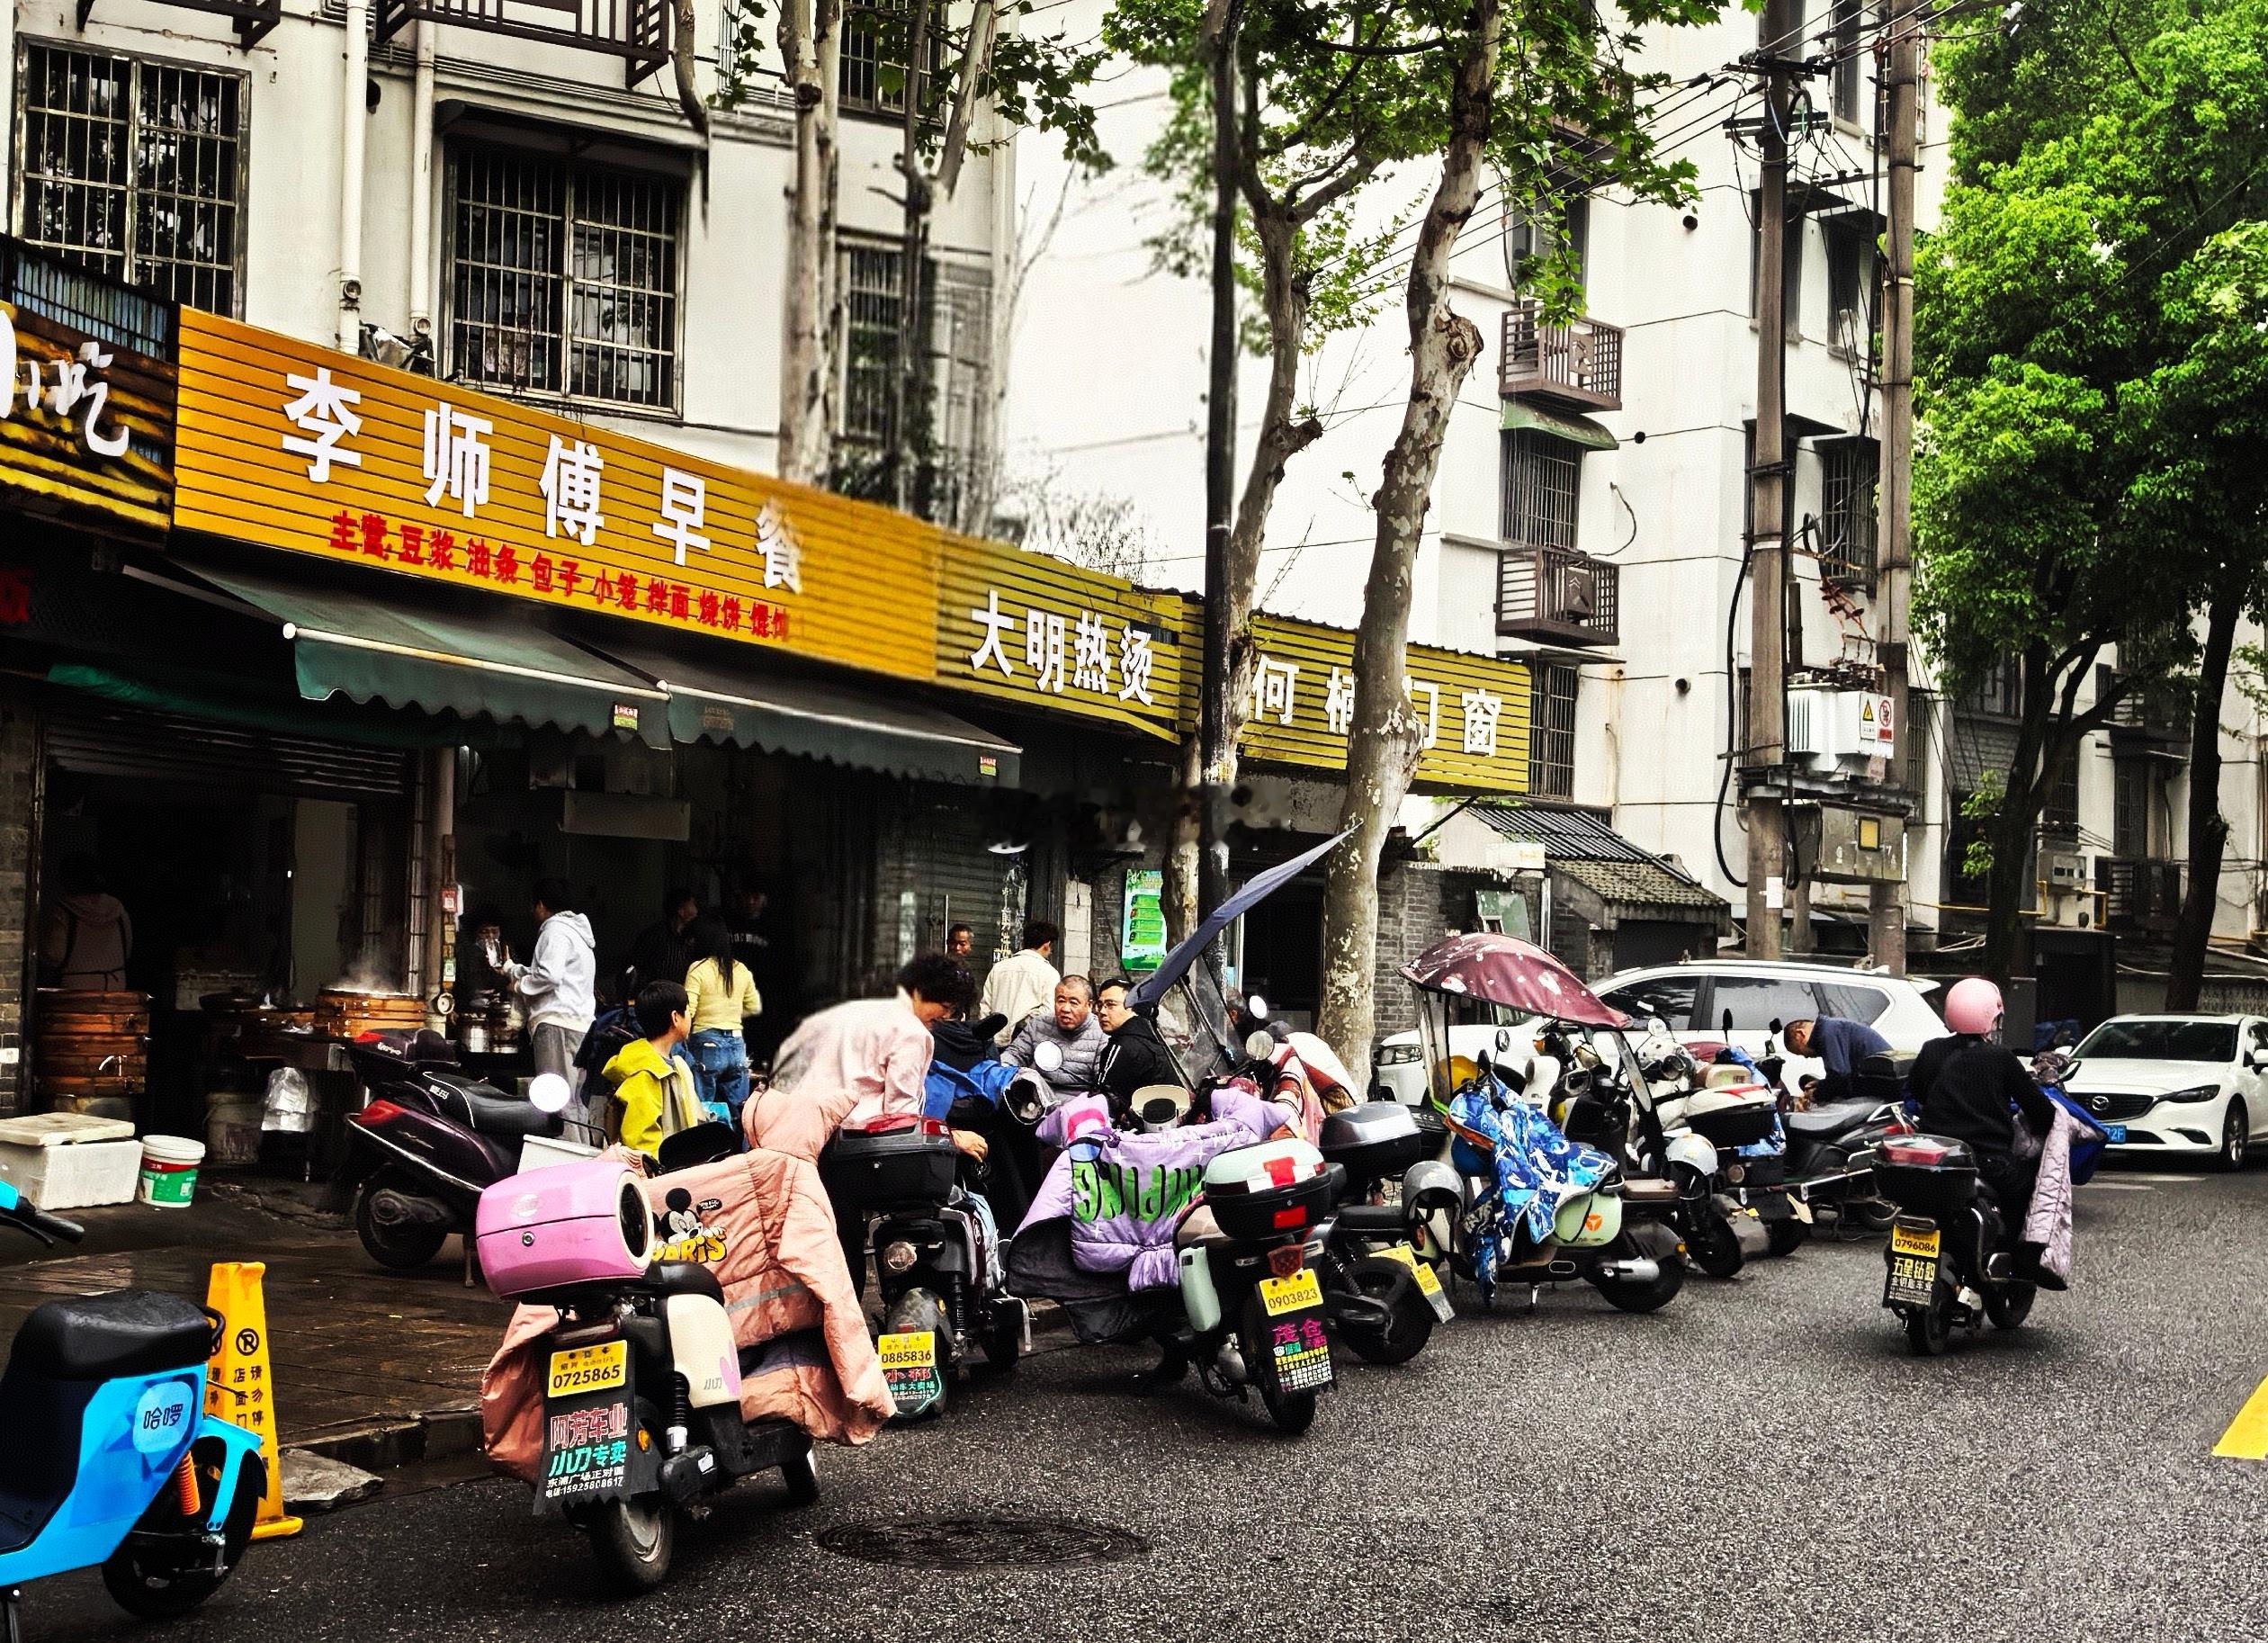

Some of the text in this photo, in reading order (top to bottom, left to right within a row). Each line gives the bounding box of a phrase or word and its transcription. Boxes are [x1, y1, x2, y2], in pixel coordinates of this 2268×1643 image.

[282, 366, 802, 594] 李师傅早餐
[530, 551, 581, 597] 包子
[970, 589, 1154, 706] 大明热烫
[1895, 1238, 1937, 1252] 0796086
[1268, 1288, 1319, 1309] 0903823
[882, 1350, 932, 1364] 0885836
[552, 1364, 622, 1389] 0725865
[550, 1402, 628, 1451] 阿芳车业
[549, 1441, 627, 1477] 小刀专卖
